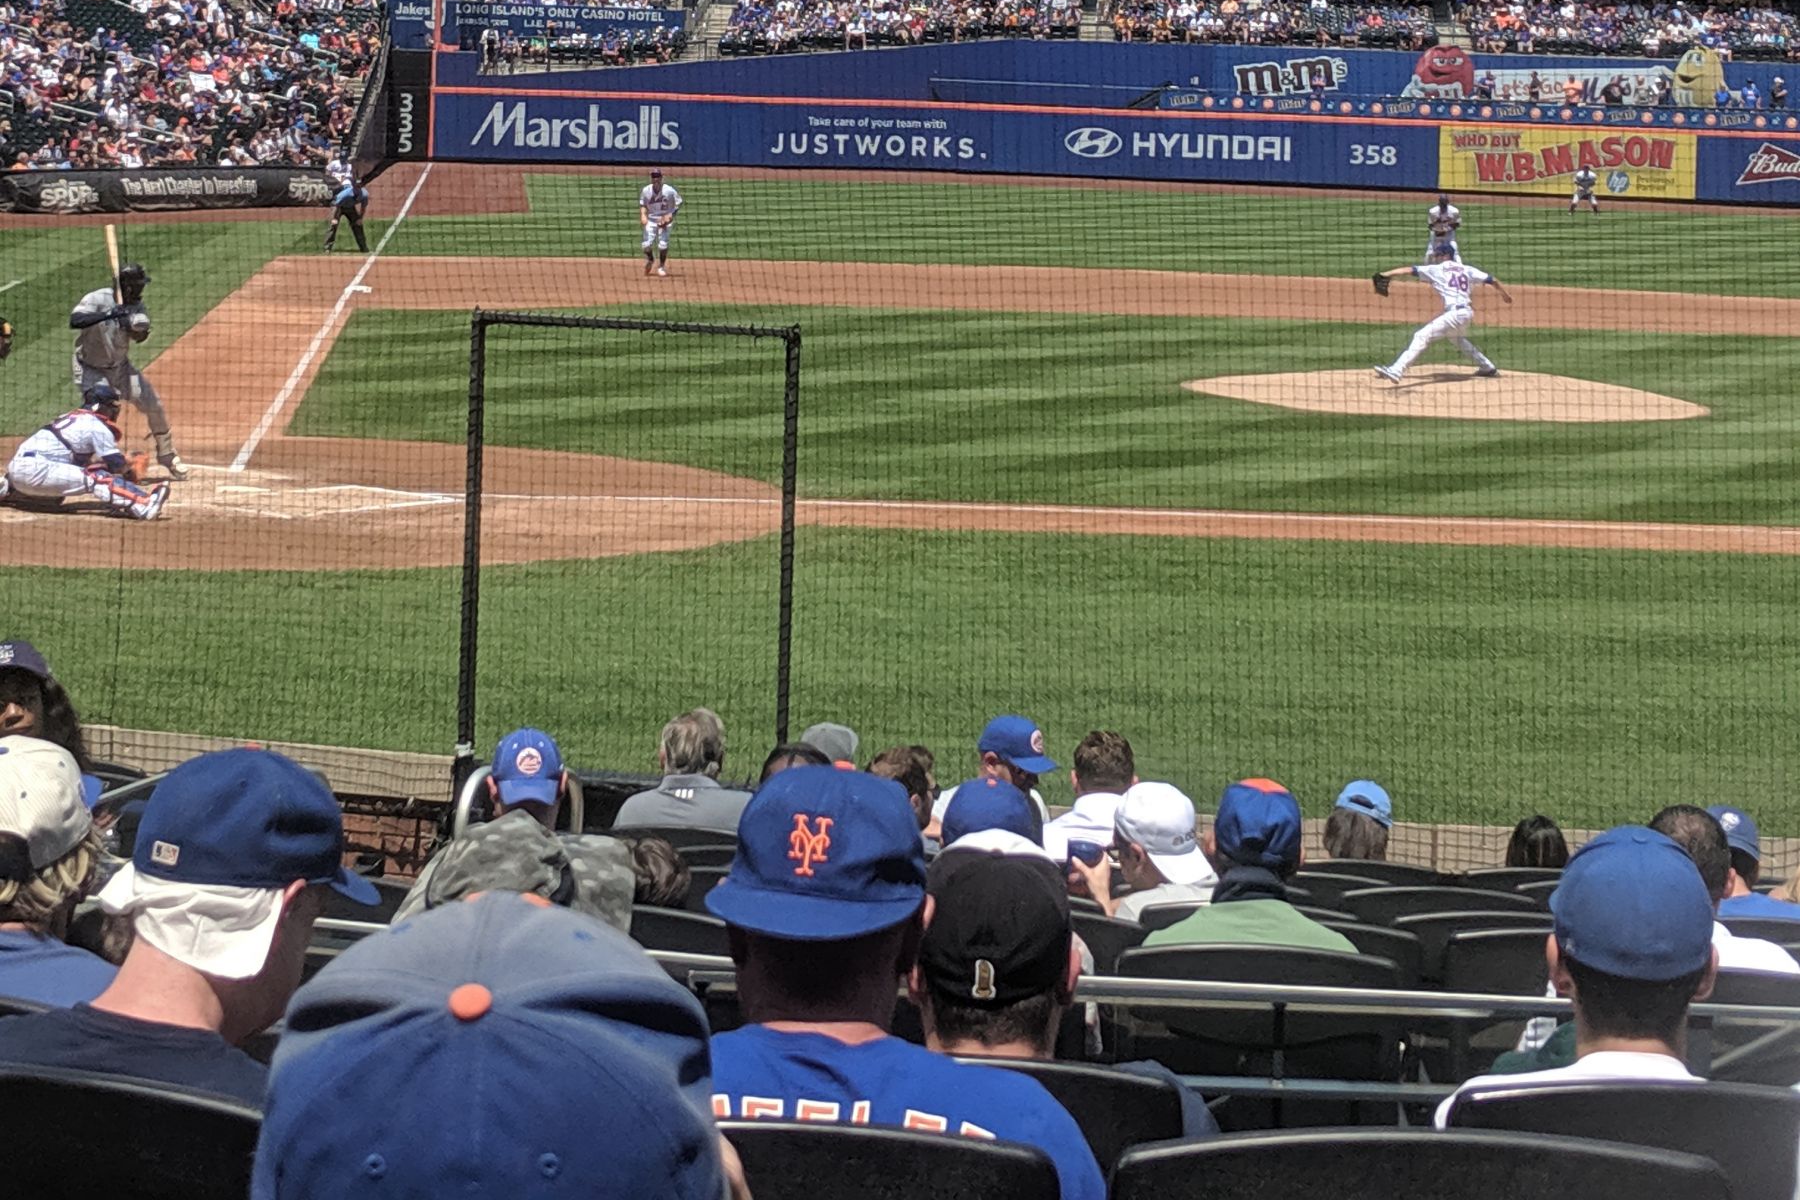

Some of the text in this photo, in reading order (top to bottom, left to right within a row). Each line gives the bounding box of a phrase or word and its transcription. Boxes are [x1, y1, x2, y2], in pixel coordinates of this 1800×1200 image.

[456, 4, 665, 22] LONG ISLAND'S ONLY CASINO HOTEL
[470, 102, 679, 150] Marshalls
[808, 116, 947, 130] Take care of your team with
[771, 133, 987, 160] JUSTWORKS.
[1133, 132, 1291, 161] HYUNDAI
[1454, 135, 1521, 148] WHO BUT
[1350, 144, 1397, 166] 358
[1609, 171, 1628, 193] hp
[1448, 272, 1469, 293] 48
